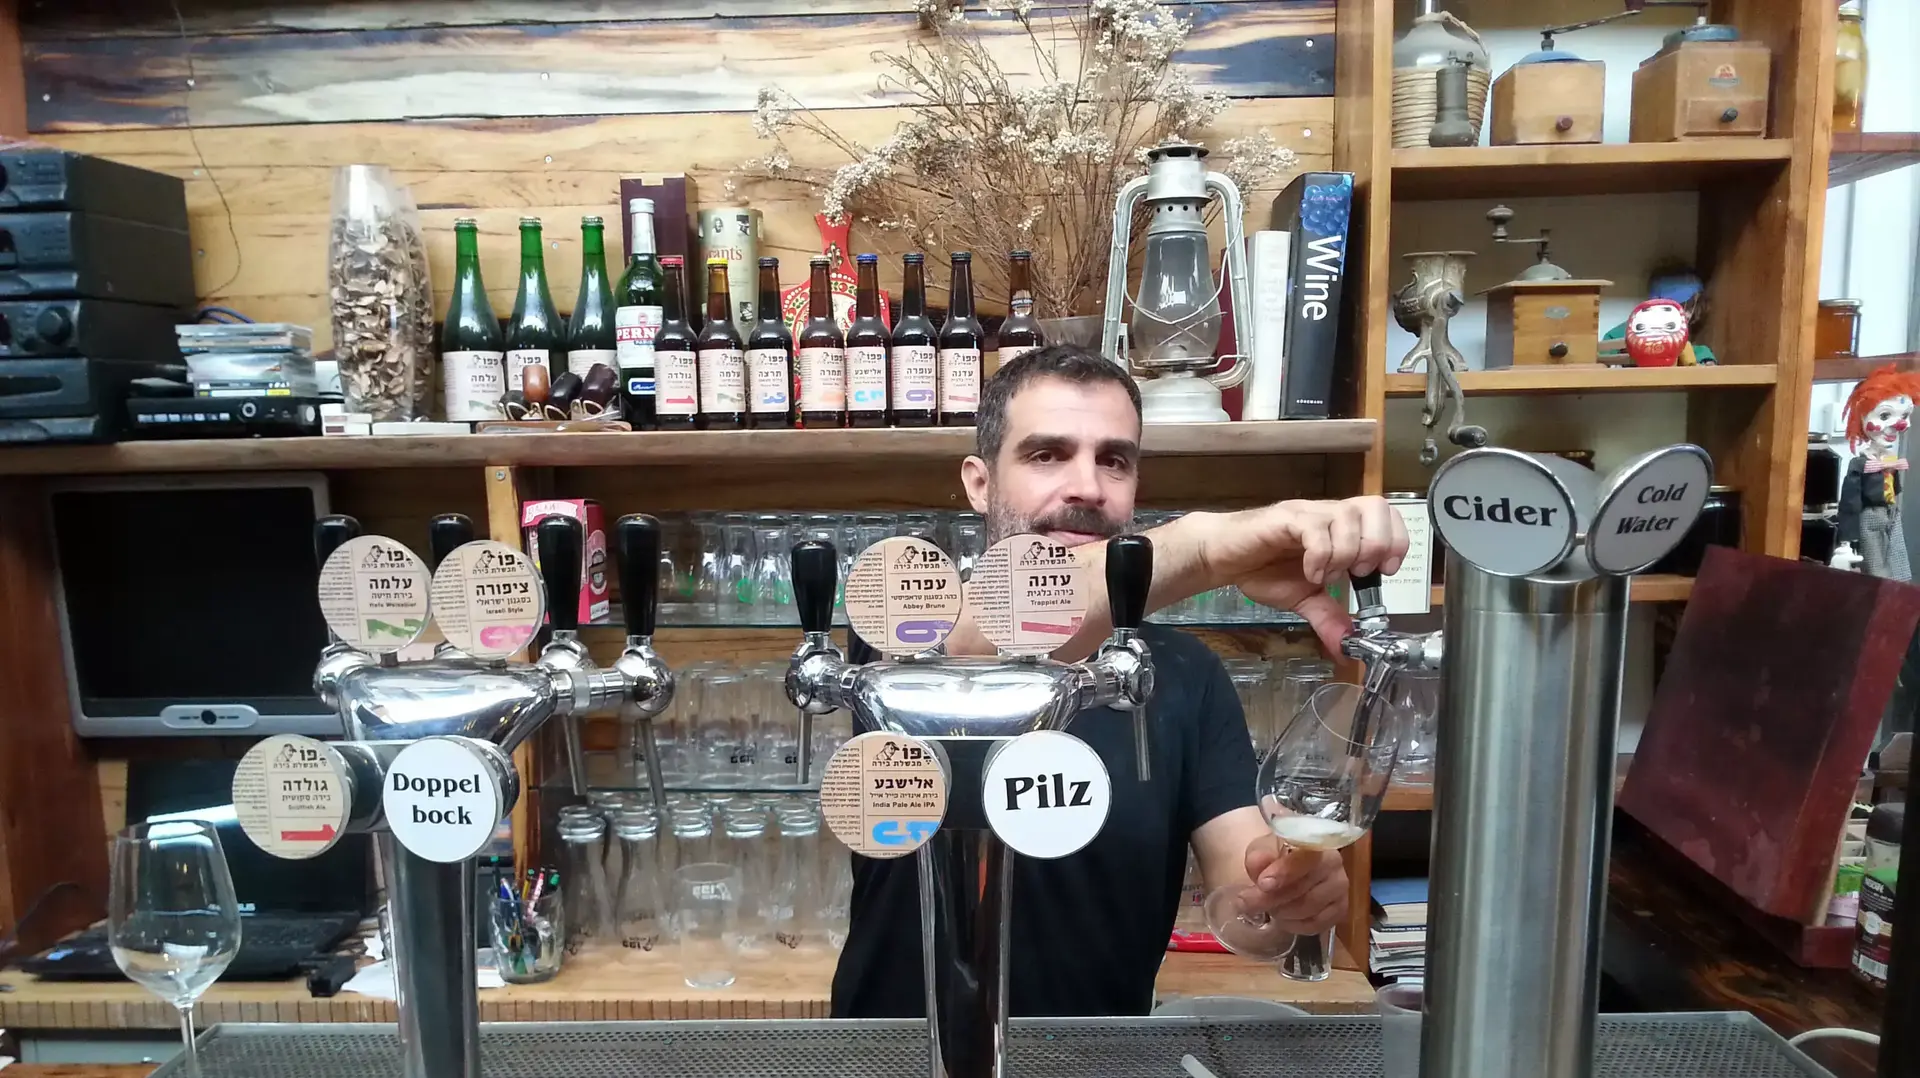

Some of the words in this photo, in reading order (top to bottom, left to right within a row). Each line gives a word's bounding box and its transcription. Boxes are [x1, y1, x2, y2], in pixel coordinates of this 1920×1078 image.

[1301, 234, 1343, 321] Wine
[616, 327, 655, 339] PERN
[471, 373, 497, 382] עלמה
[1637, 482, 1689, 504] Cold
[1443, 495, 1558, 527] Cider
[1615, 514, 1679, 535] Water
[369, 576, 413, 589] עלמה
[901, 579, 947, 590] עפרה
[1029, 574, 1072, 587] עדנה
[476, 582, 529, 596] ציפורה
[1027, 589, 1052, 597] בלגית
[1054, 588, 1074, 596] בירה
[476, 598, 505, 606] ישראלי
[507, 596, 532, 605] בסגנון
[283, 778, 328, 791] גולדה
[392, 772, 481, 797] Doppel
[874, 776, 934, 789] אלישבע
[1003, 772, 1093, 811] Pilz
[412, 804, 473, 825] bock
